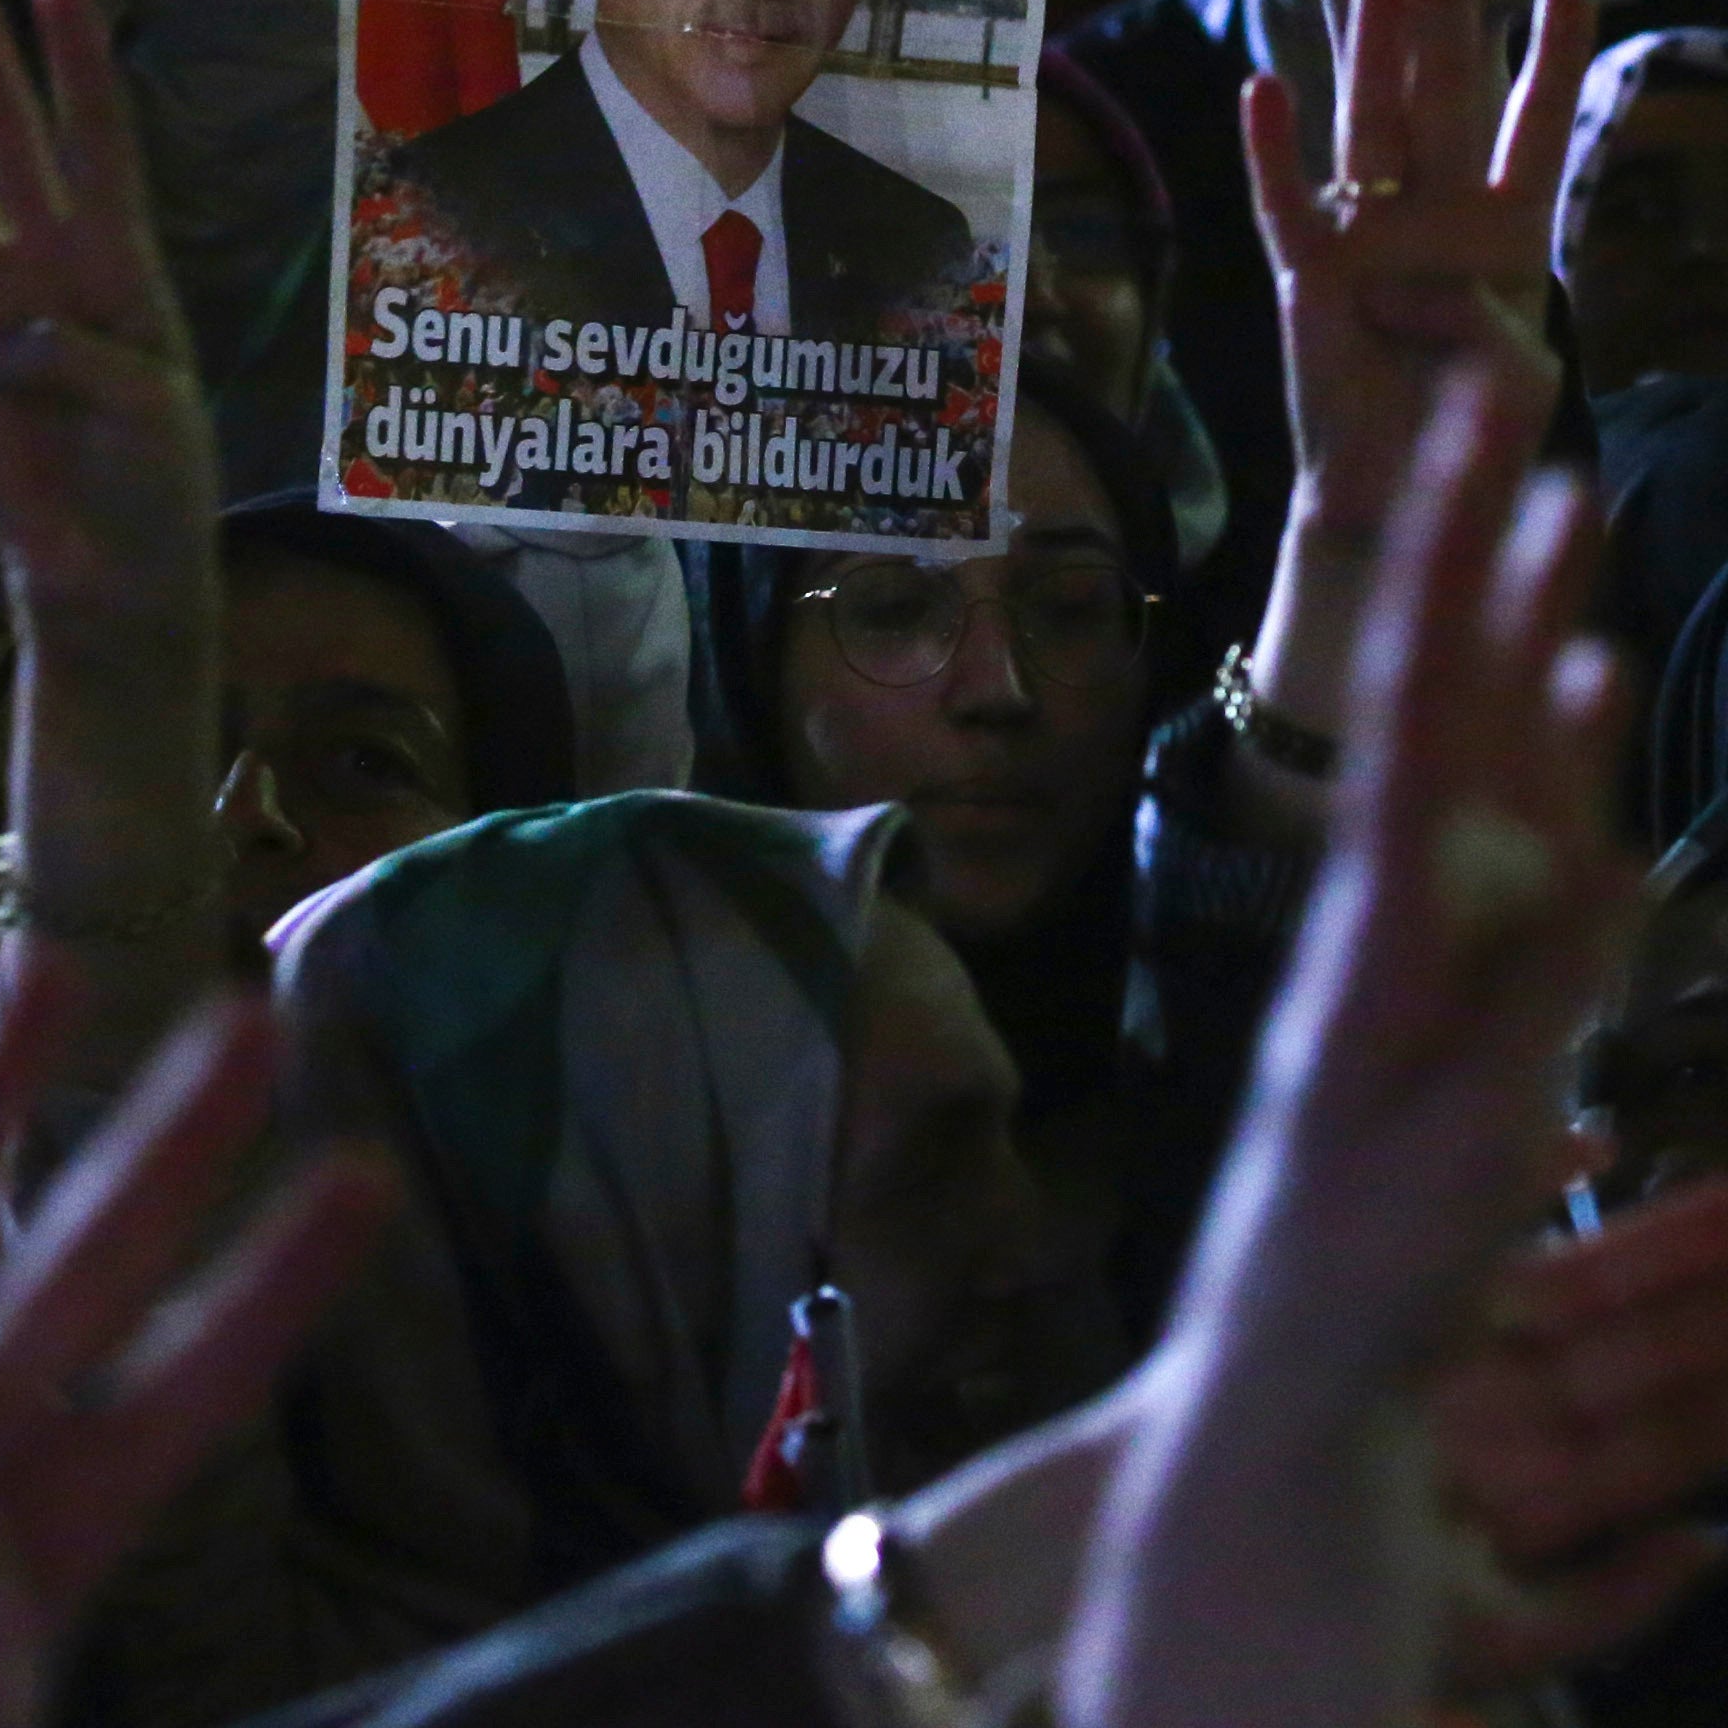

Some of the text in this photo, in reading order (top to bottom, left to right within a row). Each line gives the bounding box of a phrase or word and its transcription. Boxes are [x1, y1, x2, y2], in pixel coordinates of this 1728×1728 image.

[371, 285, 940, 405] Senu sevduğumuzu
[365, 384, 968, 501] dünyalara bildurduk
